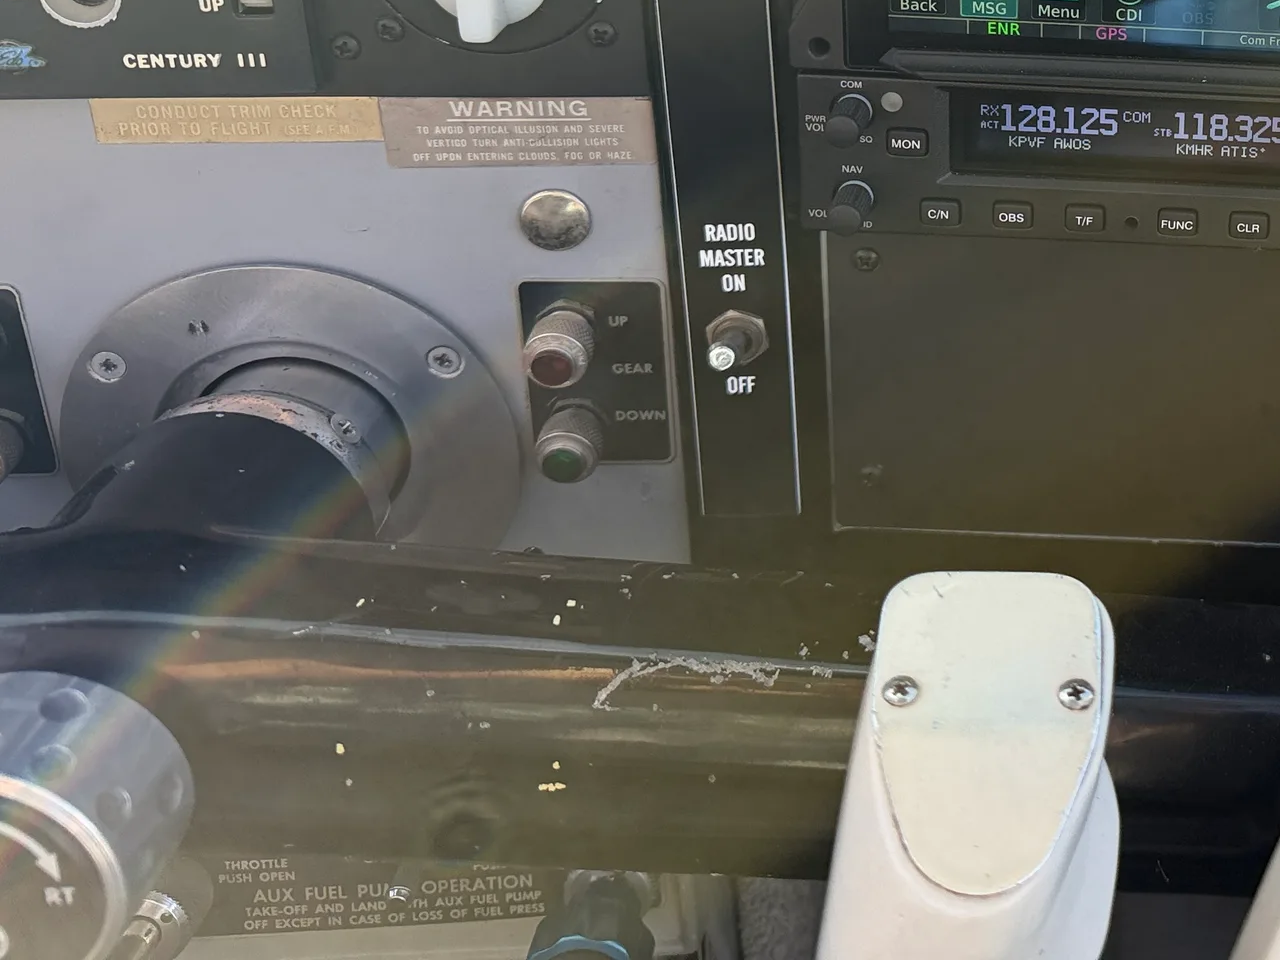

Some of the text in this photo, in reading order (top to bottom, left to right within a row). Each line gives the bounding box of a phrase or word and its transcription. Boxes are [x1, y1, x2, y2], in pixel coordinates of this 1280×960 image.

[972, 1, 1007, 15] MSG
[1038, 4, 1079, 19] Menu
[1116, 7, 1142, 21] CDI
[987, 22, 1020, 35] ENR
[1096, 27, 1127, 40] GPS
[123, 53, 267, 68] CENTURY III
[840, 80, 863, 88] COM
[135, 104, 337, 119] CONDUCT TRIM CHECK
[449, 100, 588, 117] WARNING
[1001, 103, 1118, 135] 128.125
[118, 121, 272, 136] PRIOR TO FLIGHT
[416, 124, 625, 135] TO AVOID OPTICAL ILLUSION AND SEVERE
[426, 137, 619, 148] VERTIGO TURN ANTI-COLLISION LIGHTS
[891, 139, 920, 149] MON
[1009, 135, 1091, 150] KPVF AWOS
[413, 153, 430, 162] OFF
[436, 153, 462, 162] UPON
[467, 152, 514, 162] ENTERING
[564, 152, 583, 161] FOG
[589, 152, 602, 160] OR
[998, 212, 1024, 223] OBS
[705, 222, 756, 242] RADIO
[1161, 220, 1194, 231] FUNC
[1237, 223, 1260, 234] CLR
[699, 248, 765, 267] MASTER
[721, 274, 746, 292] ON
[608, 315, 628, 327] UP
[612, 363, 653, 374] GEAR
[726, 375, 756, 395] OFF
[615, 410, 666, 421] DOWN
[224, 858, 289, 870] THROTTLE
[218, 871, 296, 884] PUSH OPEN
[253, 874, 534, 904] AUX FUEL OPERATION
[245, 900, 387, 918] TAKE-OFF AND LAND
